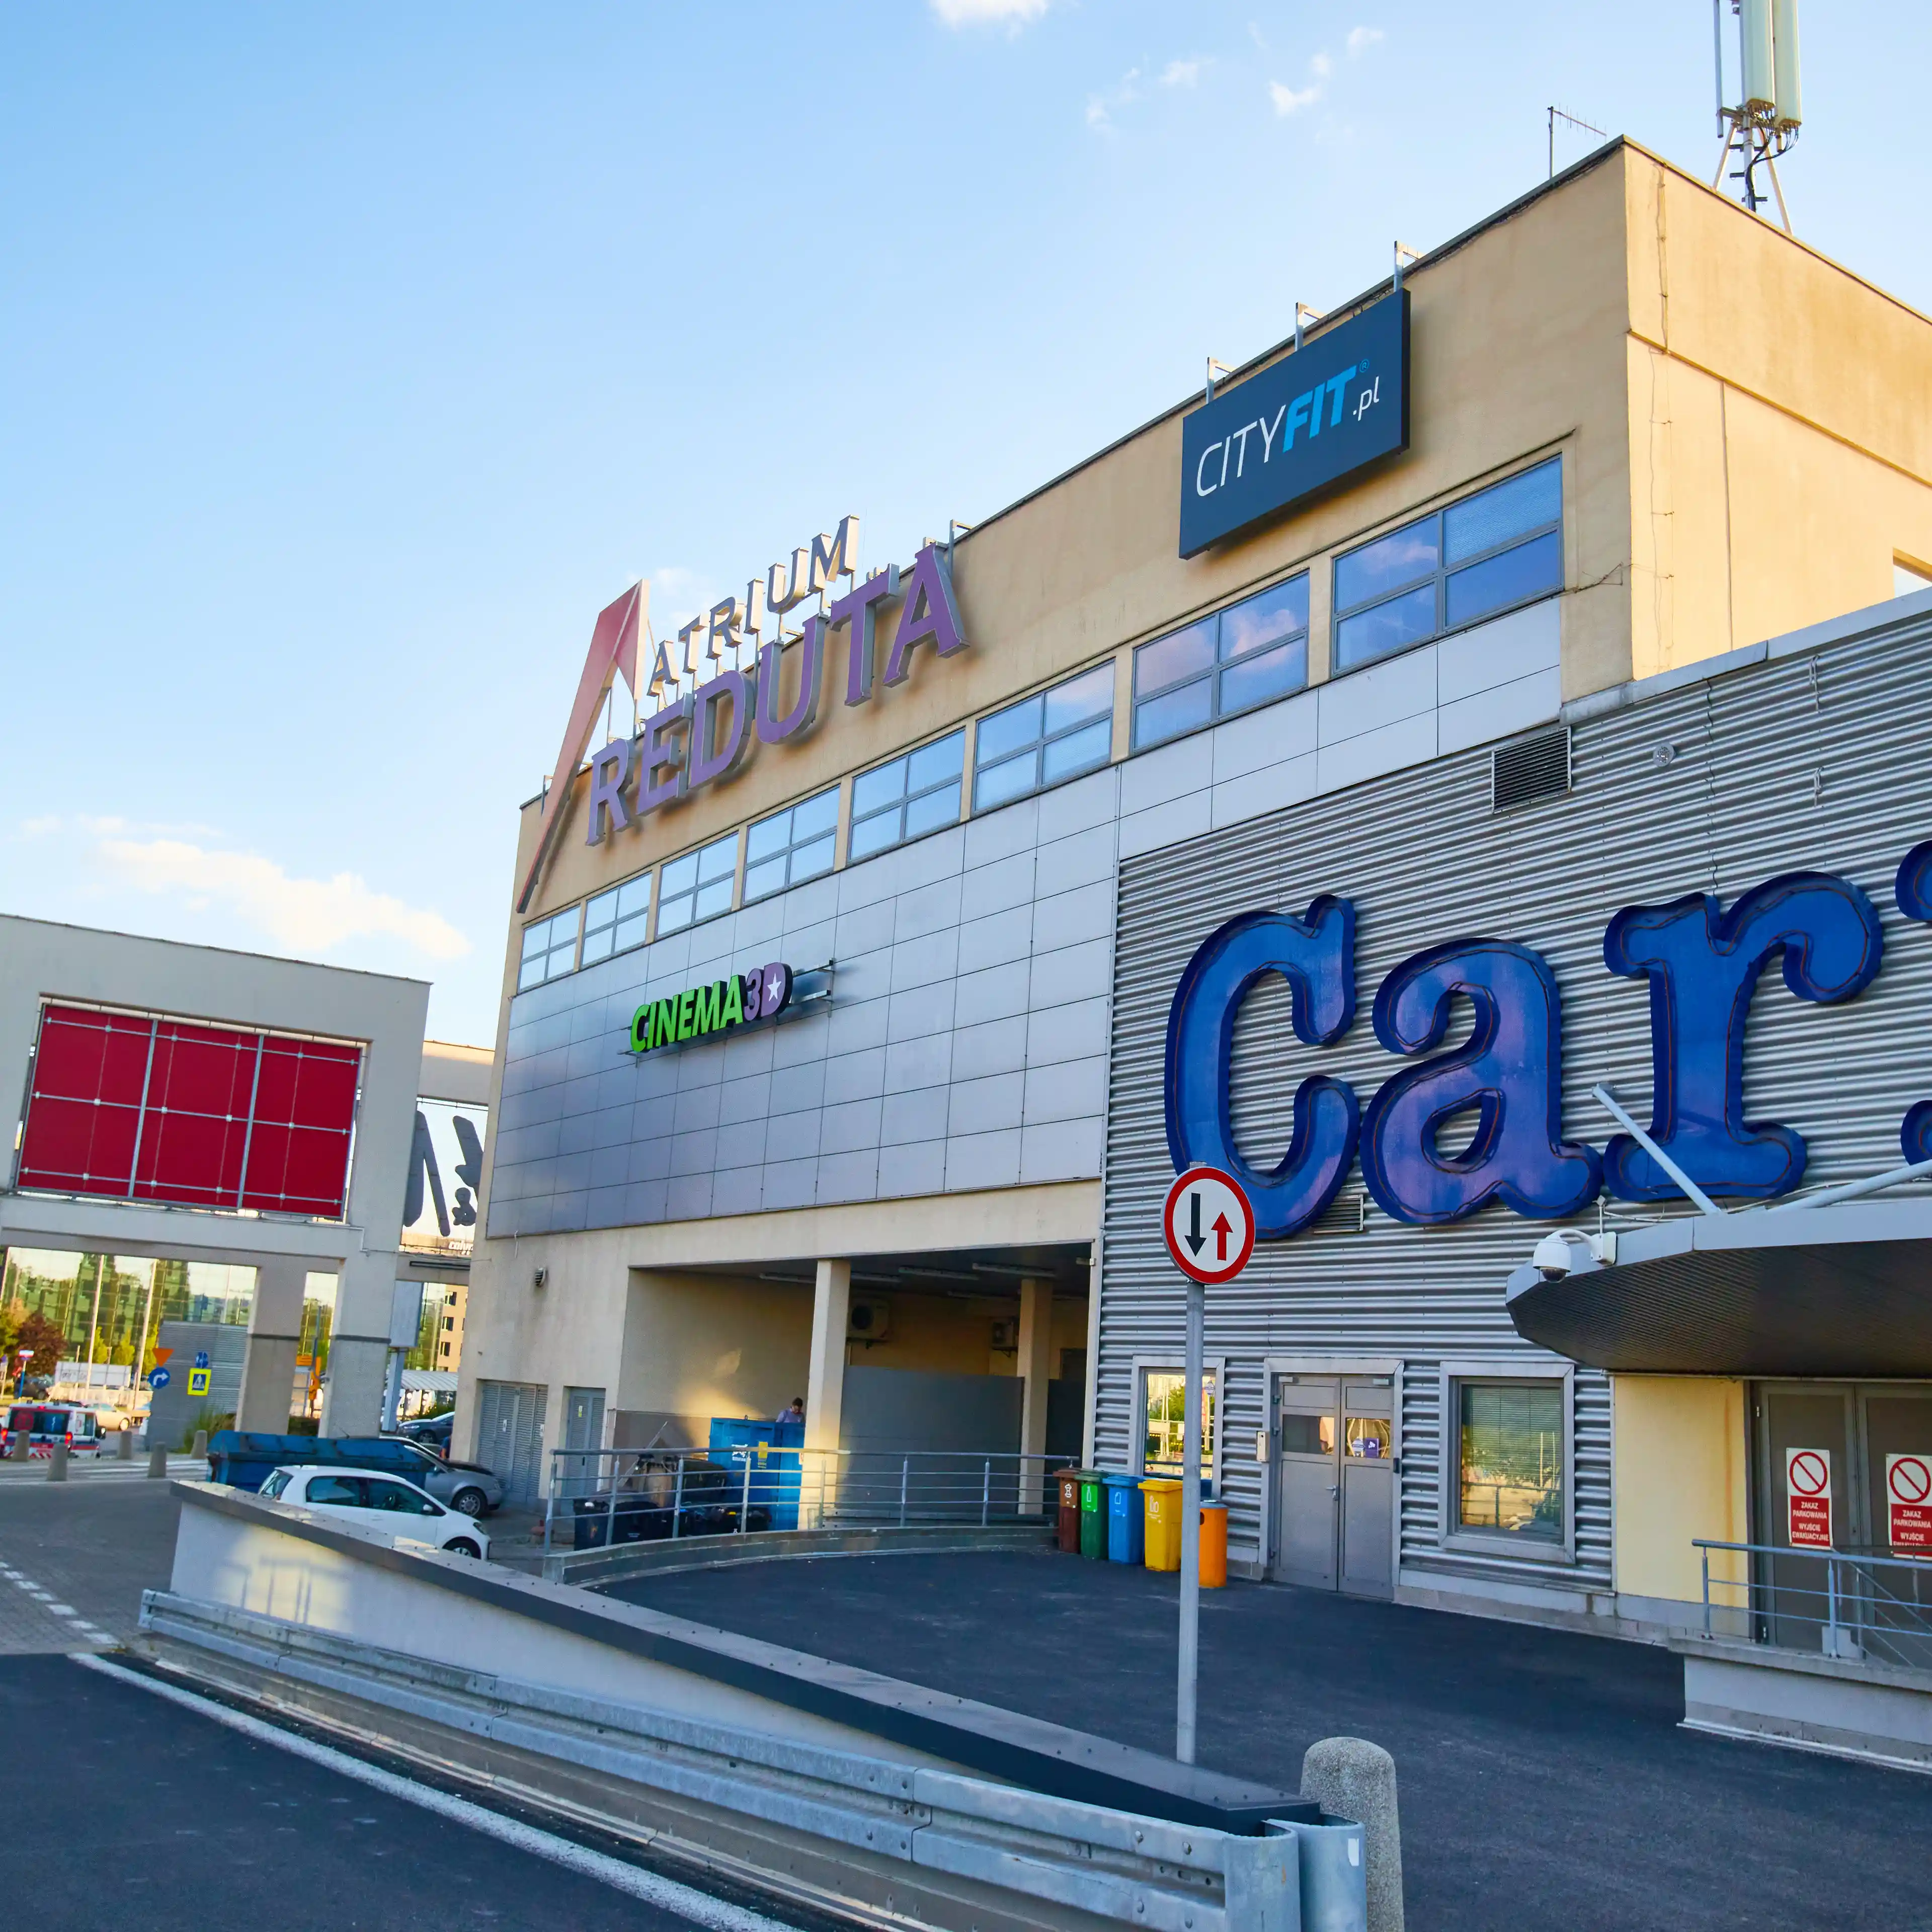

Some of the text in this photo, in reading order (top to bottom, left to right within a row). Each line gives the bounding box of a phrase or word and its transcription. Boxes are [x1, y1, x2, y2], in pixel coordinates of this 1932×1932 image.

[647, 514, 859, 697] ATRIUM
[585, 541, 970, 846] REDUTA
[1165, 839, 1932, 1239] Car
[1801, 1501, 1818, 1509] ZAKAZ
[1793, 1510, 1827, 1519] PARKOWANIA
[1902, 1509, 1921, 1518] ZAKAZ
[1893, 1518, 1931, 1528] PARKOWANIA
[1792, 1531, 1829, 1541] EWAKUACYJNE
